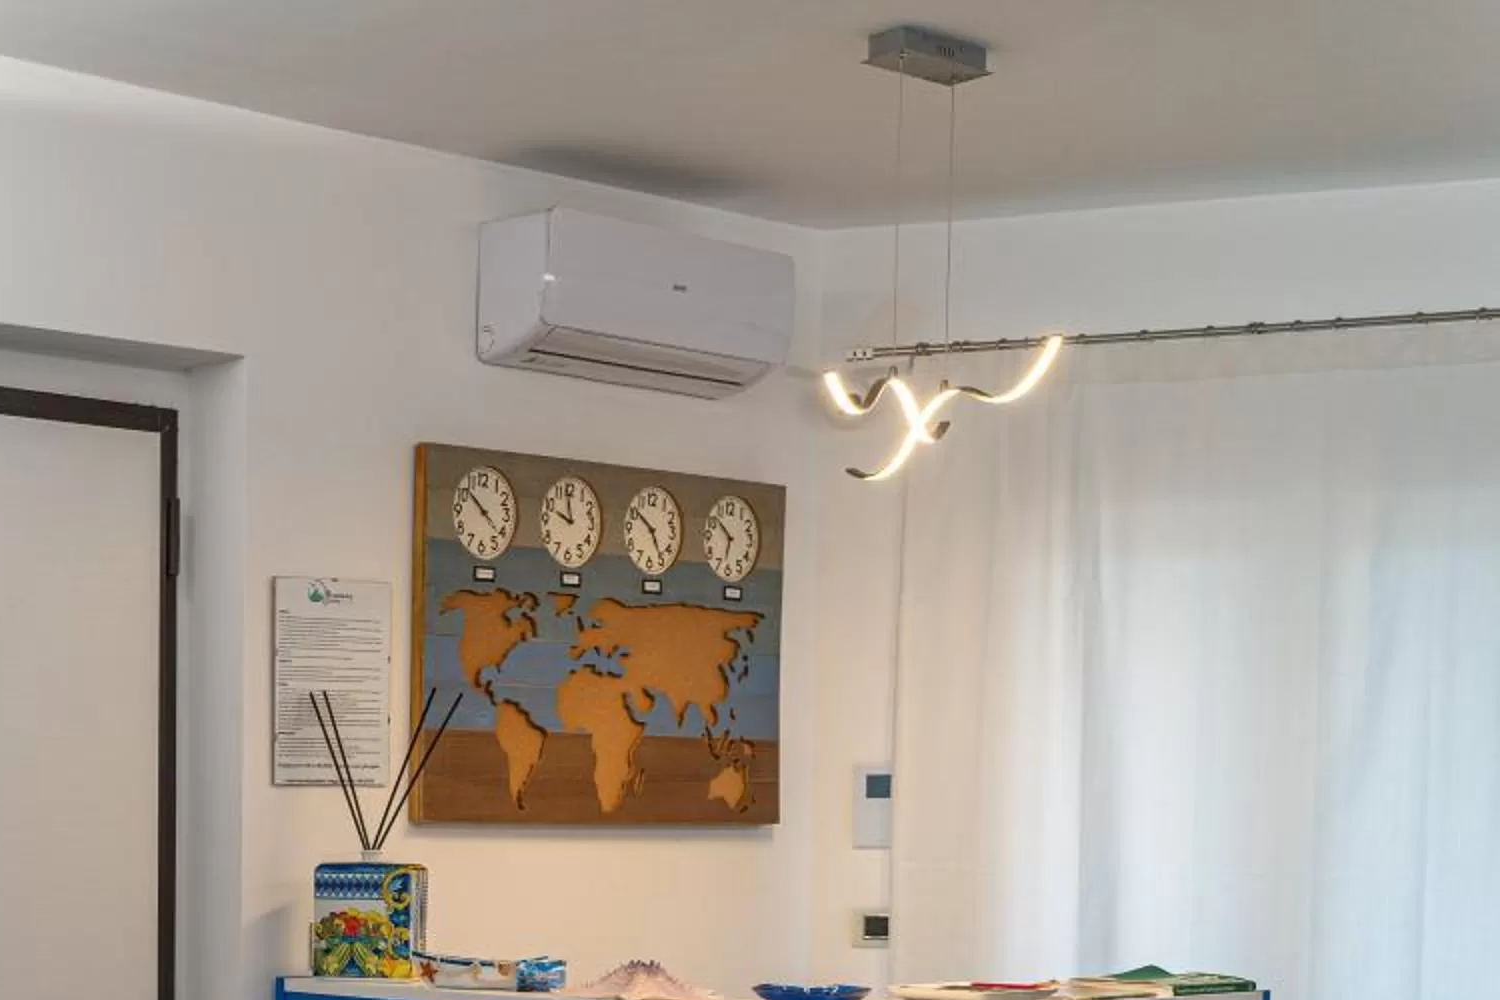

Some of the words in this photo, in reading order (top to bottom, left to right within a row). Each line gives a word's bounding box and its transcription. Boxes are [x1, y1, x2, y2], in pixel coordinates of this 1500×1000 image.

[478, 472, 489, 488] 12
[457, 488, 469, 502] 10
[566, 484, 574, 497] 12
[500, 491, 508, 506] 2
[546, 498, 554, 512] 10
[648, 493, 657, 507] 12
[453, 503, 463, 517] 9
[502, 507, 510, 522] 3
[586, 501, 593, 515] 2
[630, 507, 638, 520] 10
[726, 502, 735, 516] 12
[541, 512, 548, 526] 9
[588, 515, 594, 531] 3
[668, 511, 674, 525] 2
[706, 516, 717, 529] 10
[457, 520, 464, 535] 8
[498, 526, 506, 538] 4
[626, 522, 632, 533] 9
[745, 519, 752, 532] 2
[467, 533, 475, 546] 7
[543, 530, 550, 545] 8
[584, 534, 591, 546] 4
[669, 526, 676, 540] 3
[703, 530, 712, 541] 9
[478, 540, 486, 553] 6
[491, 536, 498, 550] 5
[627, 538, 634, 552] 8
[747, 533, 753, 548] 3
[554, 542, 561, 554] 7
[564, 548, 572, 561] 6
[576, 544, 584, 558] 5
[665, 544, 672, 554] 4
[707, 546, 713, 559] 8
[636, 550, 644, 562] 7
[646, 556, 652, 568] 6
[658, 552, 664, 566] 5
[743, 551, 749, 562] 4
[716, 558, 722, 571] 7
[724, 564, 732, 577] 6
[736, 560, 742, 575] 5
